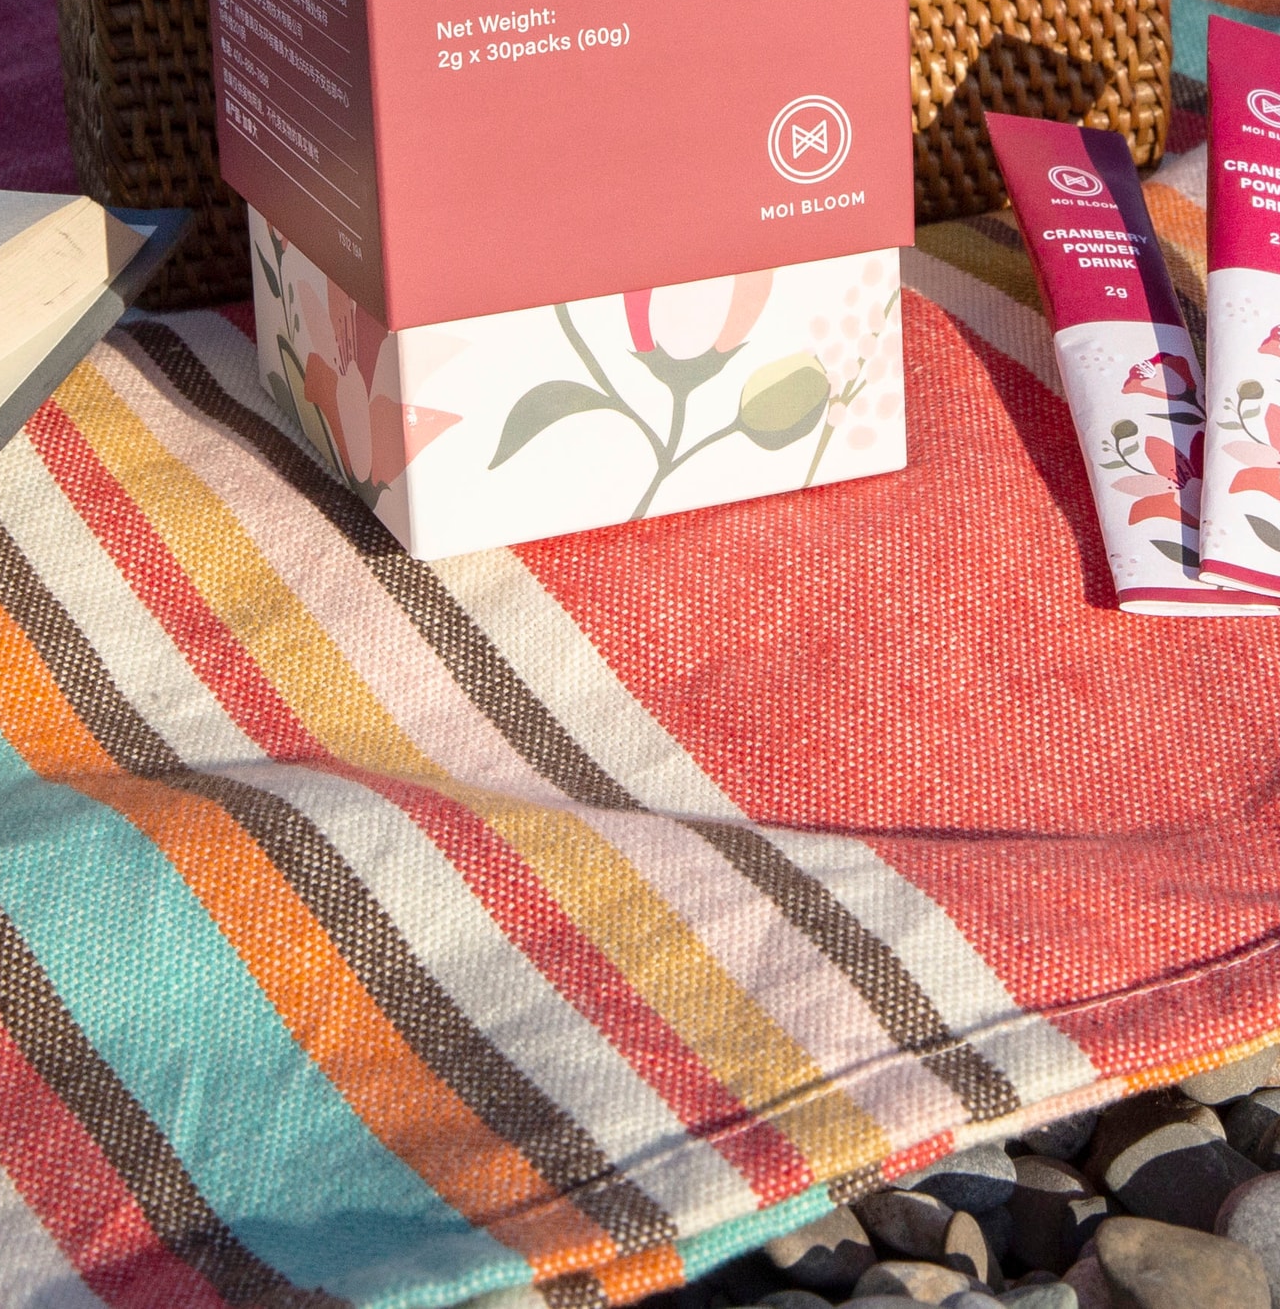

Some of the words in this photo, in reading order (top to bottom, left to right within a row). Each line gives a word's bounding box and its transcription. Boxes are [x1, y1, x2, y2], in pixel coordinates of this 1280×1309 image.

[437, 18, 473, 40] Net
[479, 8, 556, 35] Weight:
[437, 49, 463, 70] 2g
[469, 49, 481, 63] x
[486, 33, 571, 61] 30packs
[577, 23, 630, 51] (60g)
[1242, 125, 1264, 136] MOI
[761, 202, 794, 221] MOI
[801, 190, 865, 214] BLOOM
[1077, 199, 1118, 209] BLOOM
[1042, 229, 1148, 244] CRANBERRY
[1063, 243, 1141, 256] POWDER
[1078, 257, 1136, 269] DRINK
[1104, 285, 1128, 298] 2g
